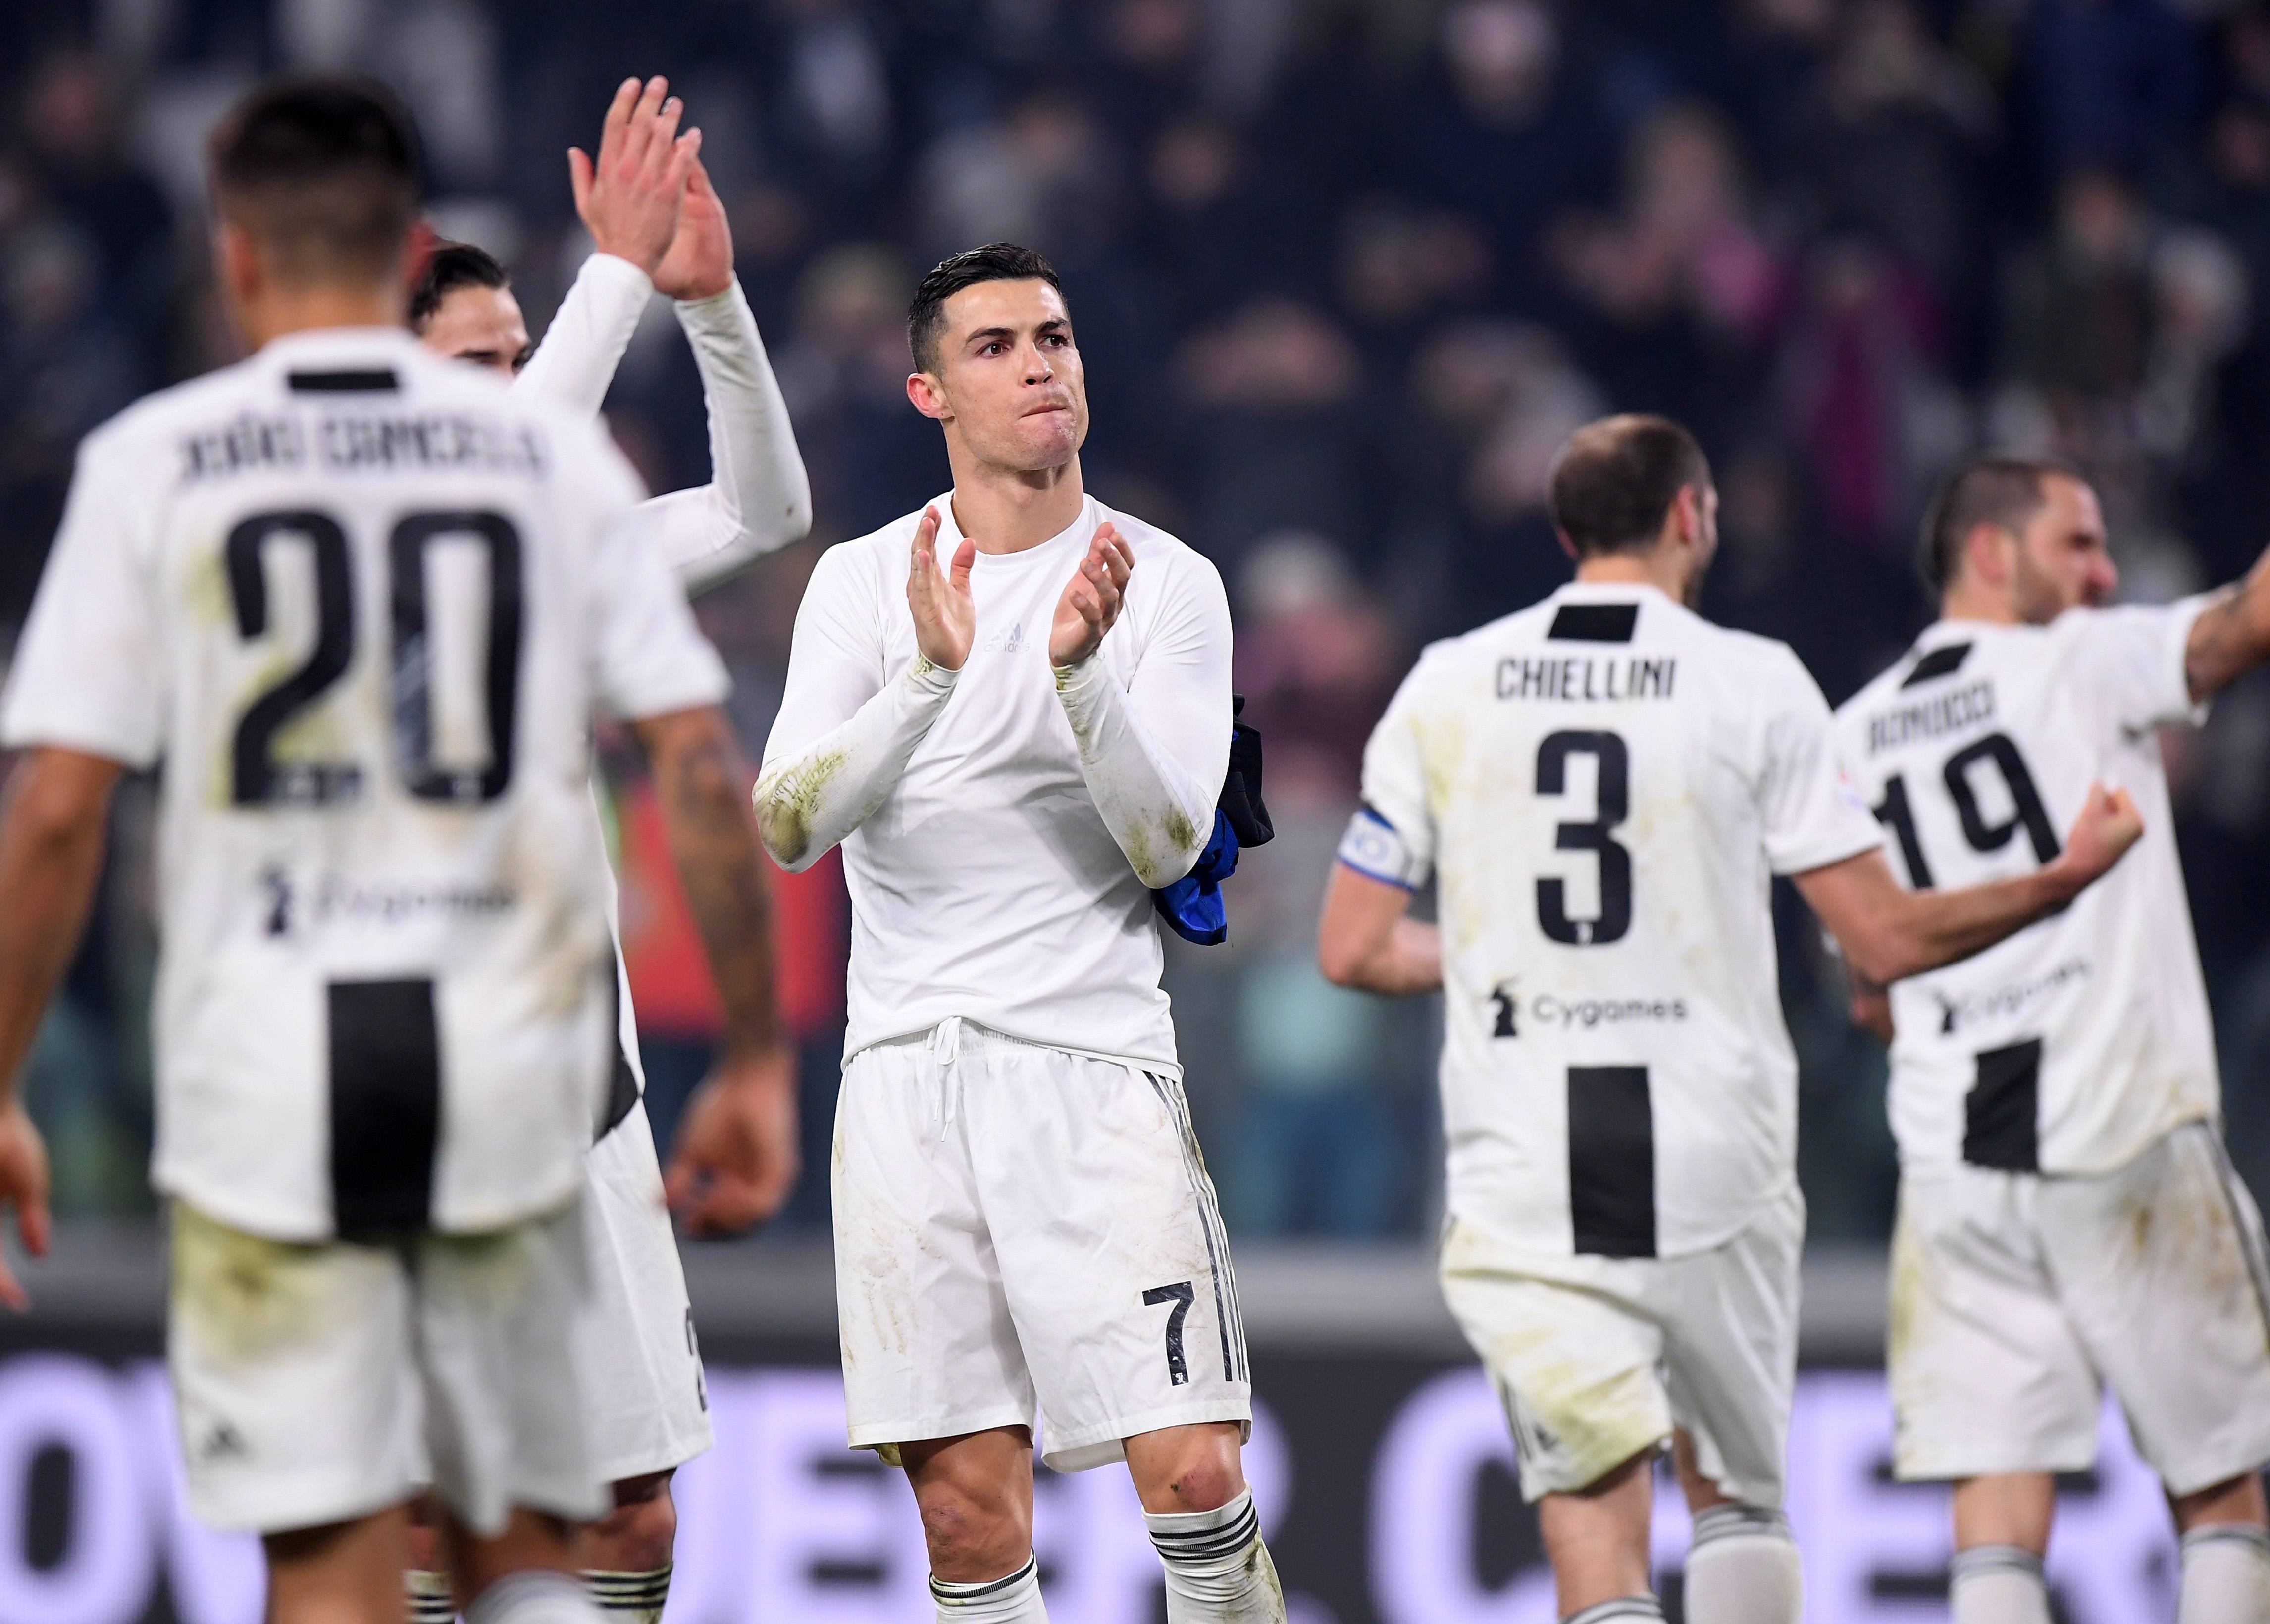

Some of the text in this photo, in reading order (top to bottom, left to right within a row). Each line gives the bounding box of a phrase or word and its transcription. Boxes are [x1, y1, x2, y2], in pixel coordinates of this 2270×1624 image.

[224, 507, 522, 809] 20
[1496, 658, 1676, 700] CHIELLINI
[1535, 729, 1632, 947] 3
[1873, 730, 2062, 892] 19
[1531, 993, 1688, 1032] Cygames
[1141, 1280, 1195, 1386] 7
